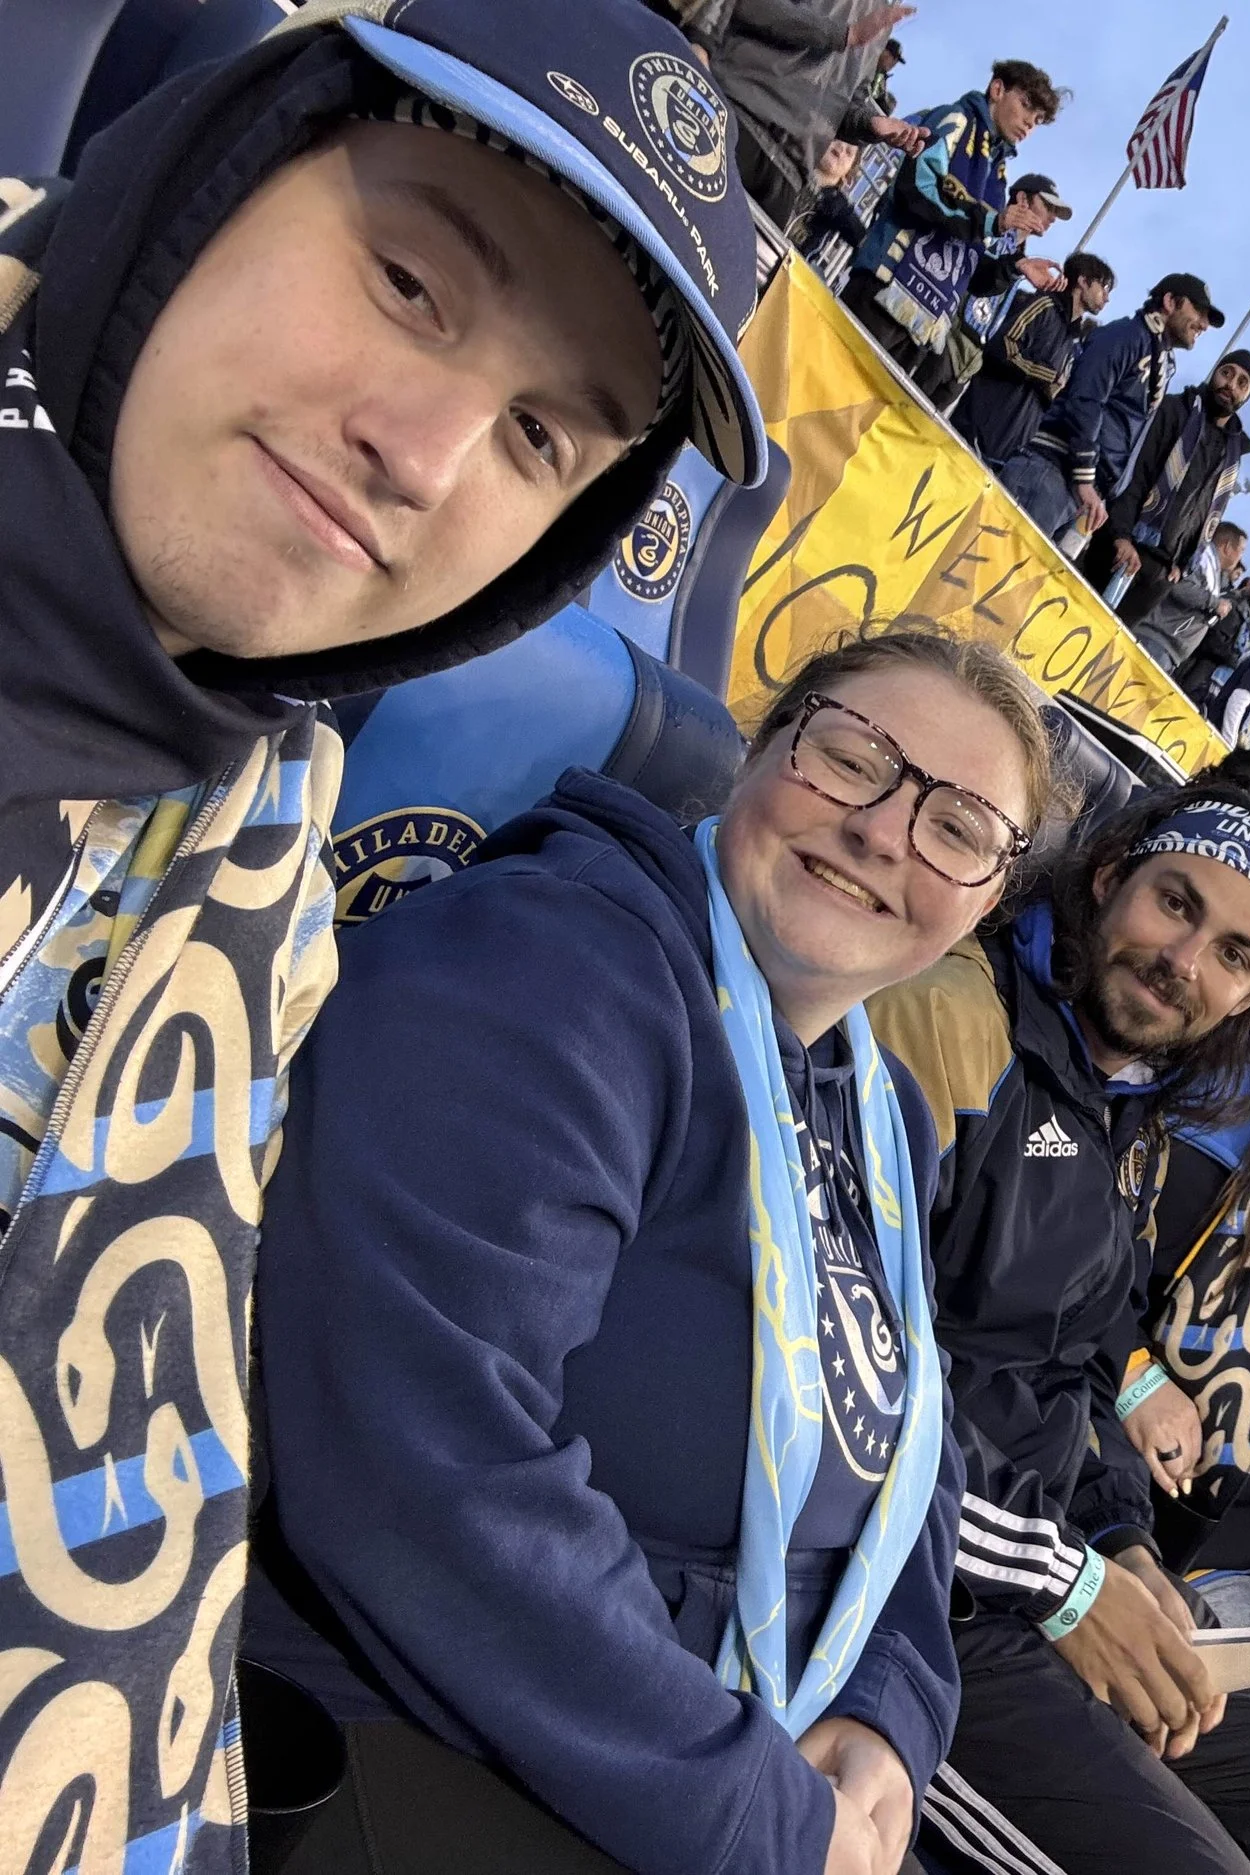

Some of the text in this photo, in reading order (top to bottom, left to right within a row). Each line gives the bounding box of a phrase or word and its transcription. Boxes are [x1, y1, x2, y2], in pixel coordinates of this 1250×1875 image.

[676, 89, 718, 138] UNION
[603, 115, 719, 298] SUBARU PARK
[644, 511, 673, 540] UNION
[663, 485, 690, 555] DELPHIA
[889, 463, 1147, 714] WELCOME
[1151, 715, 1188, 764] TO
[1024, 1140, 1078, 1157] adidas
[1079, 1572, 1100, 1597] The
